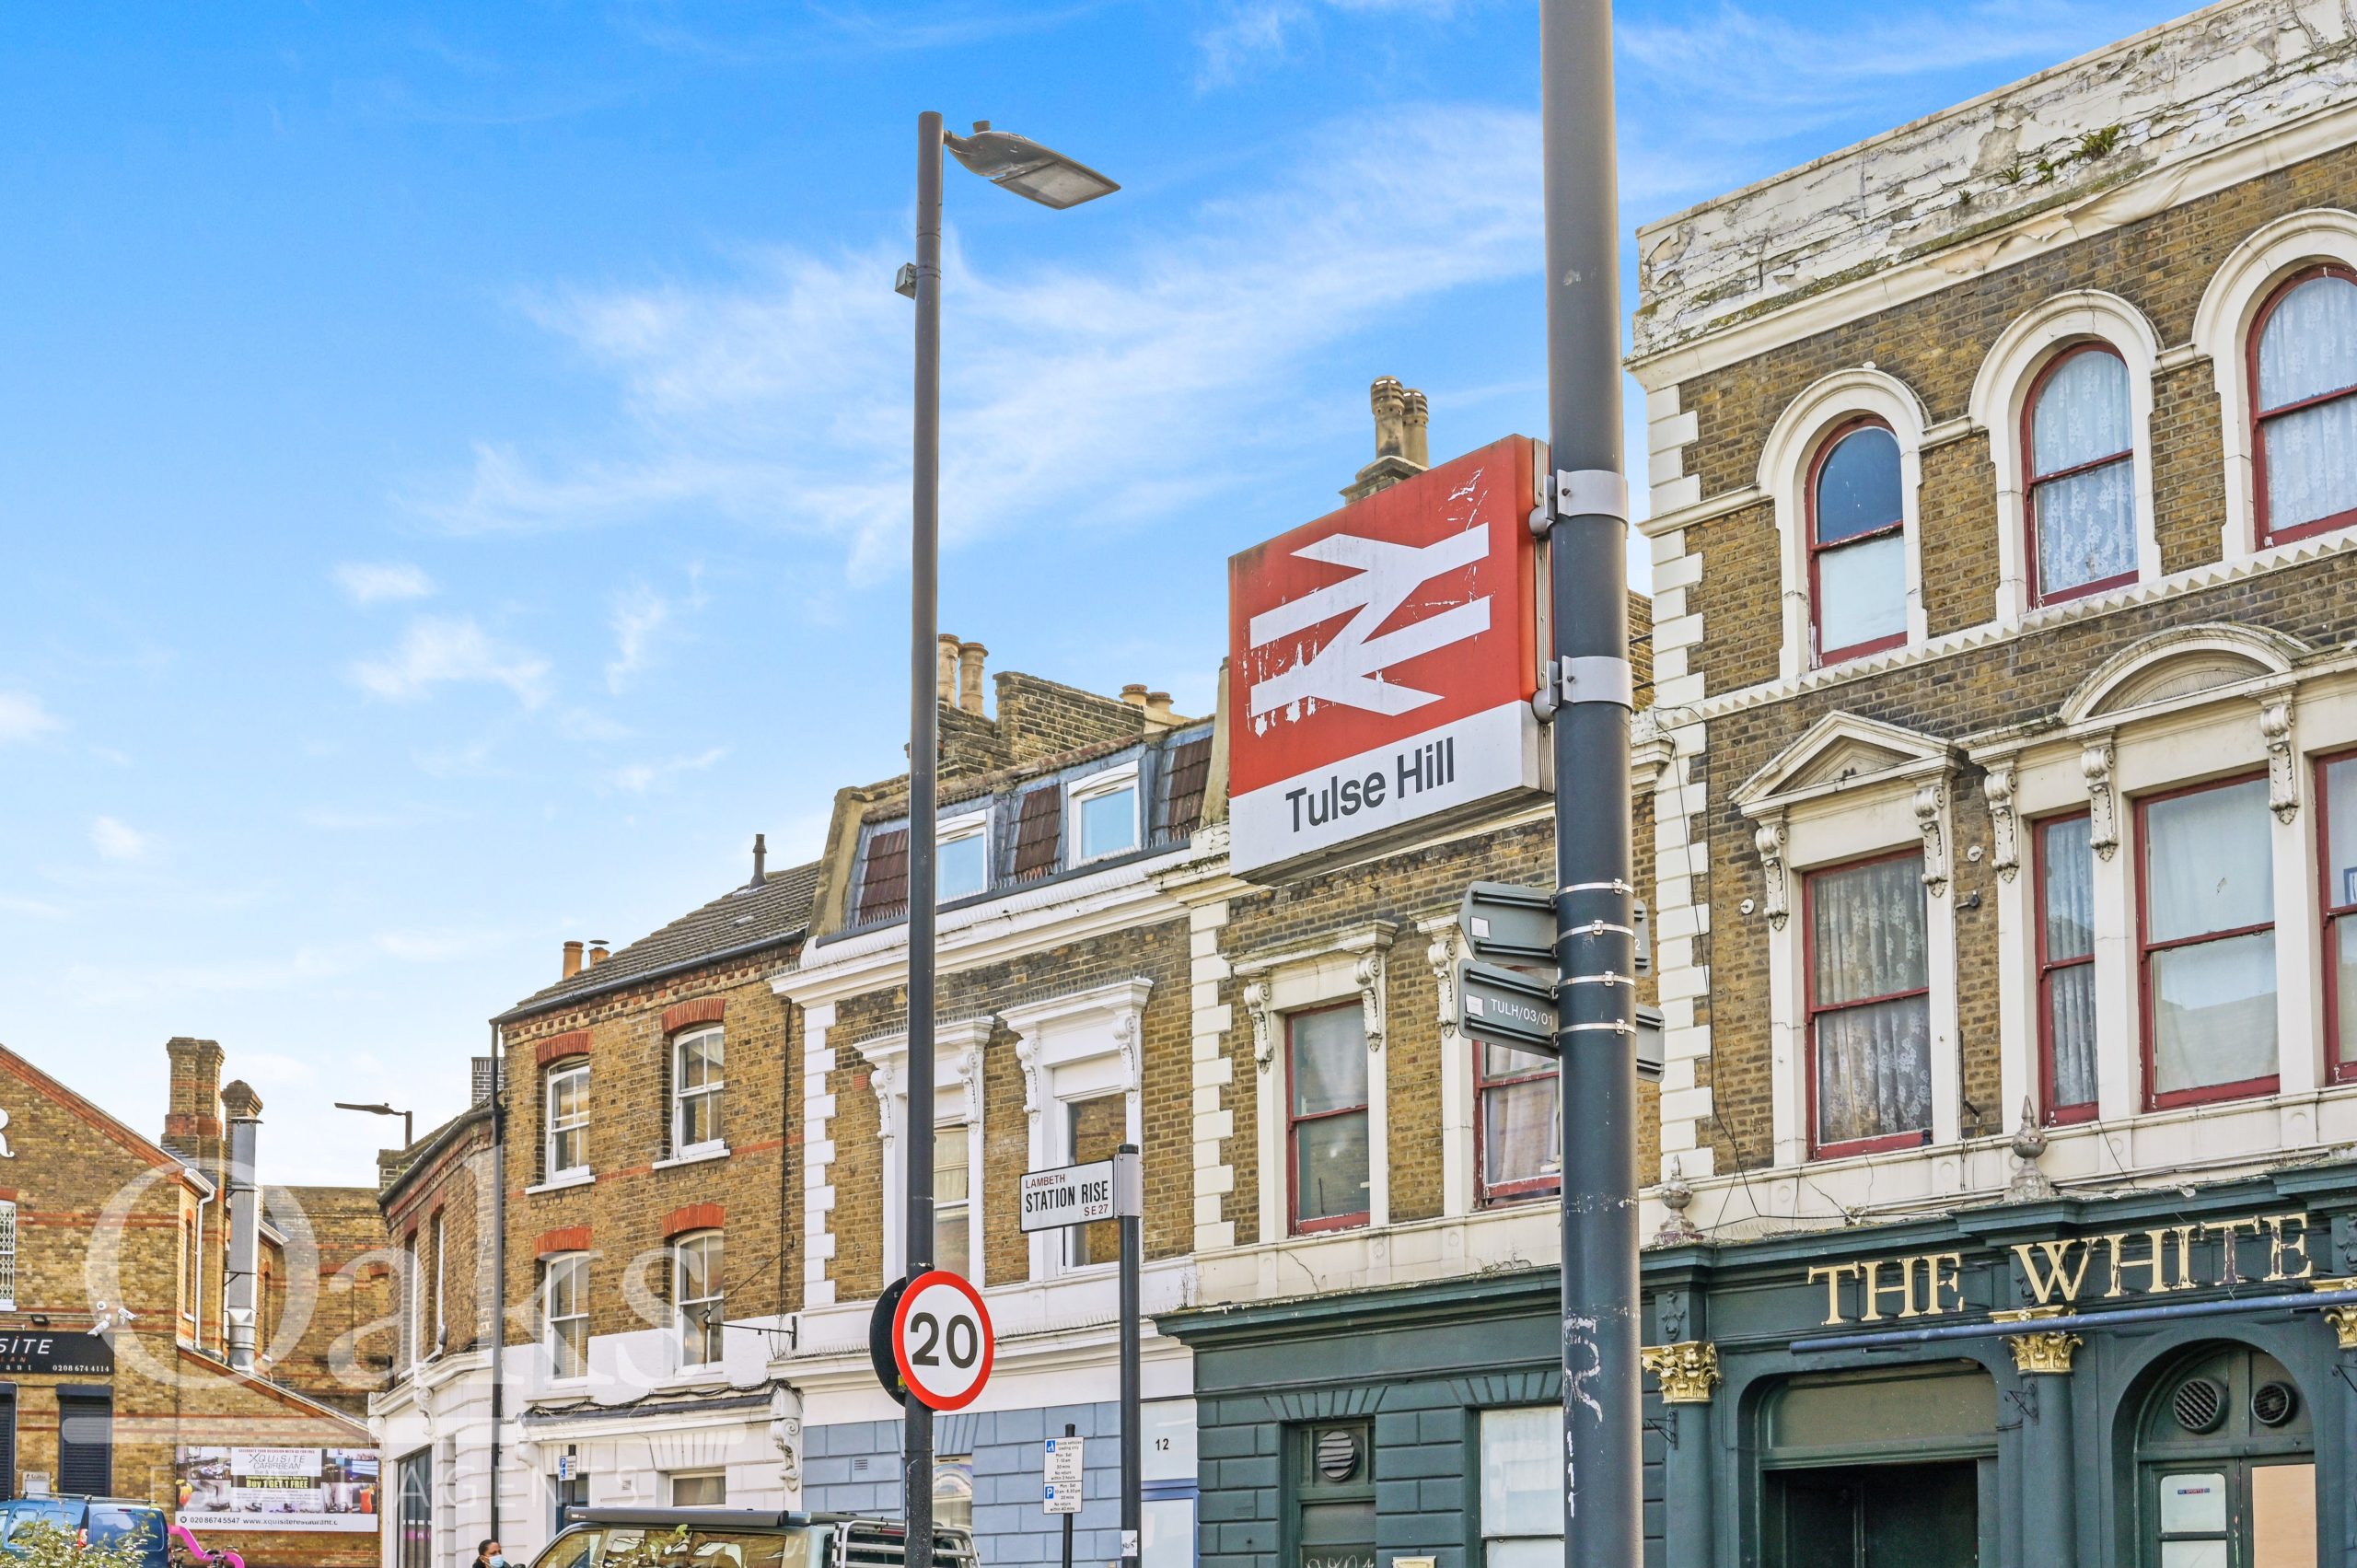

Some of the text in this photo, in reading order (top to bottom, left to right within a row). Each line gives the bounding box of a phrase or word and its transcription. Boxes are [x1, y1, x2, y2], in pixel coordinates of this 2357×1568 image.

[1285, 736, 1454, 833] Tulse Hill
[1491, 998, 1553, 1028] TULH/03/01
[1026, 1173, 1065, 1190] LAMBETH
[1026, 1179, 1109, 1214] STATION RISE
[1807, 1212, 2313, 1326] THE WHITE
[910, 1311, 978, 1369] 20
[52, 1365, 73, 1373] 0208
[75, 1365, 88, 1373] 674
[90, 1365, 110, 1373] 4114
[1155, 1437, 1169, 1451] 12
[254, 1462, 301, 1470] CARIBBEAN
[247, 1479, 308, 1489] Buy 1 GET 1 FREE
